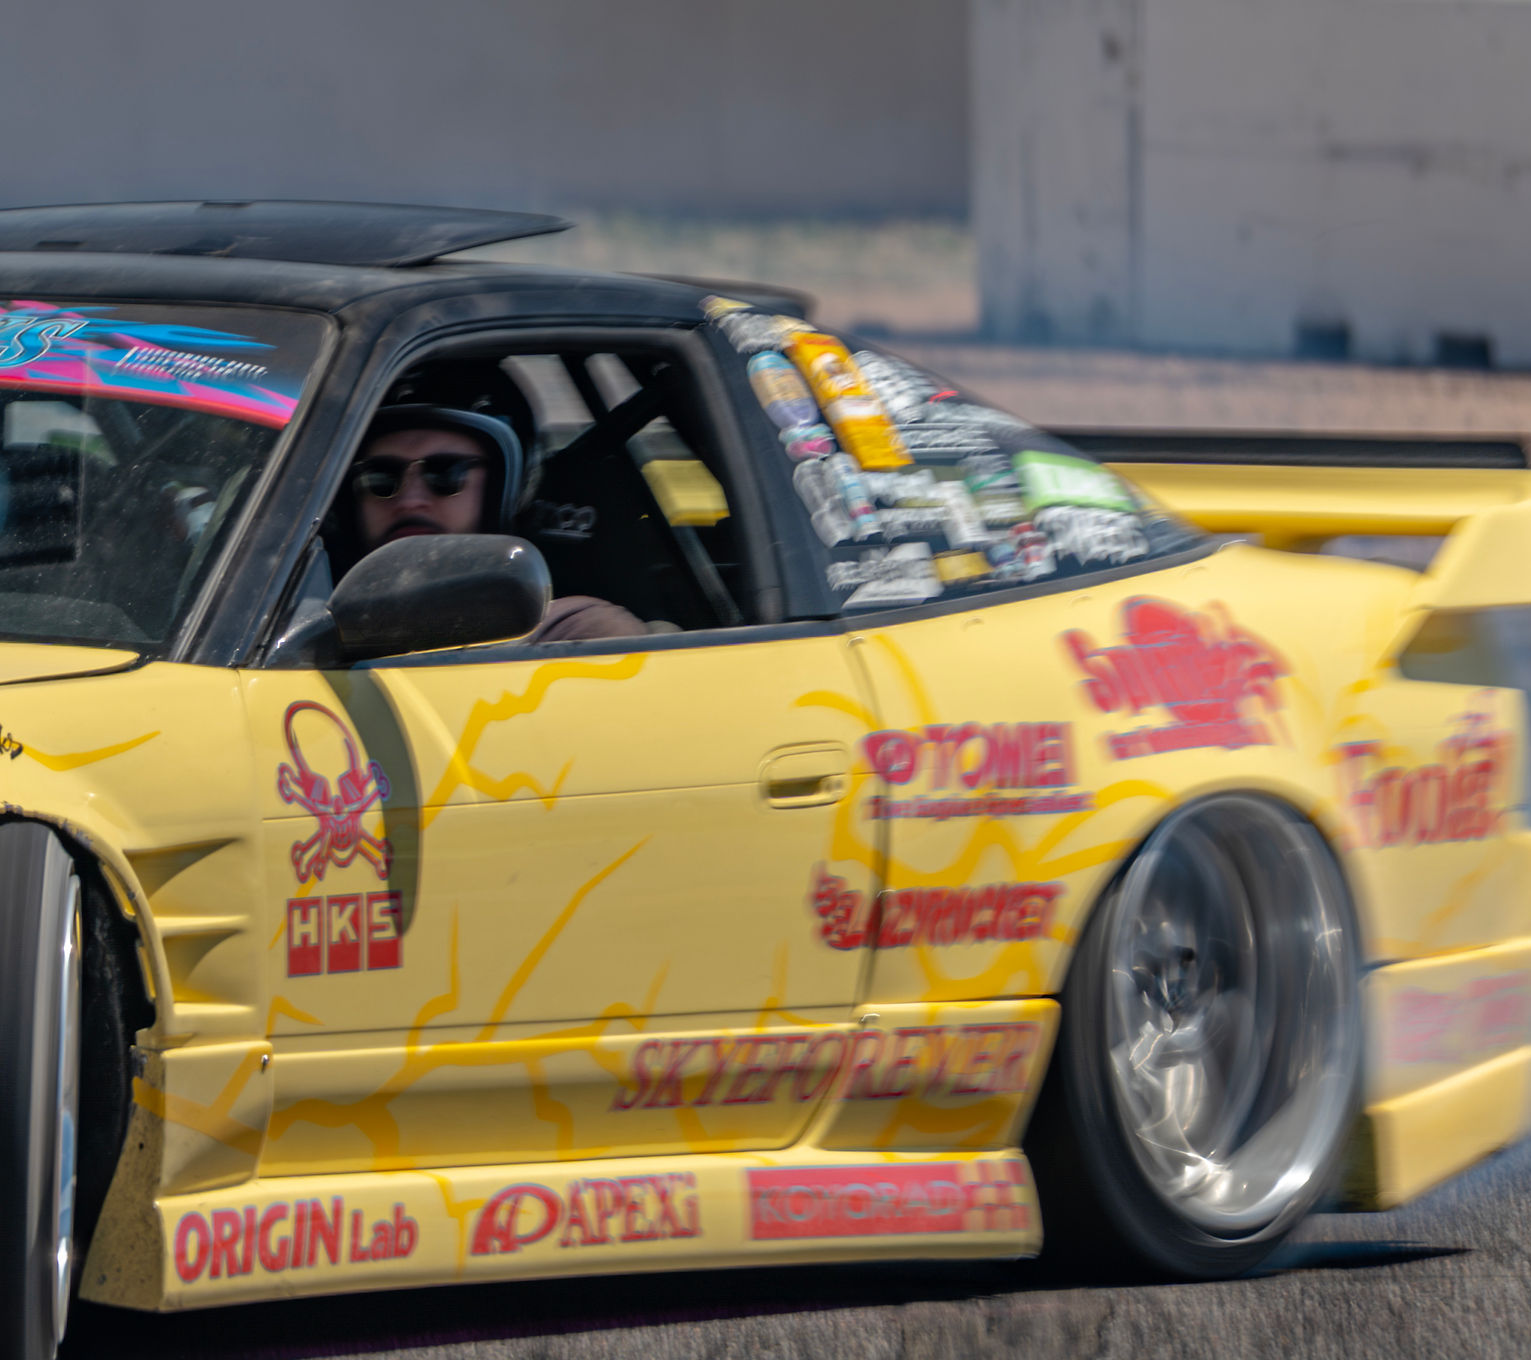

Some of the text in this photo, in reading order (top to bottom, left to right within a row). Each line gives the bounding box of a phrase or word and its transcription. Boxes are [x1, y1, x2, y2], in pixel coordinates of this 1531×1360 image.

[920, 721, 1078, 790] TOMEI
[289, 895, 399, 950] HKS
[174, 1196, 419, 1283] ORIGIN Lab
